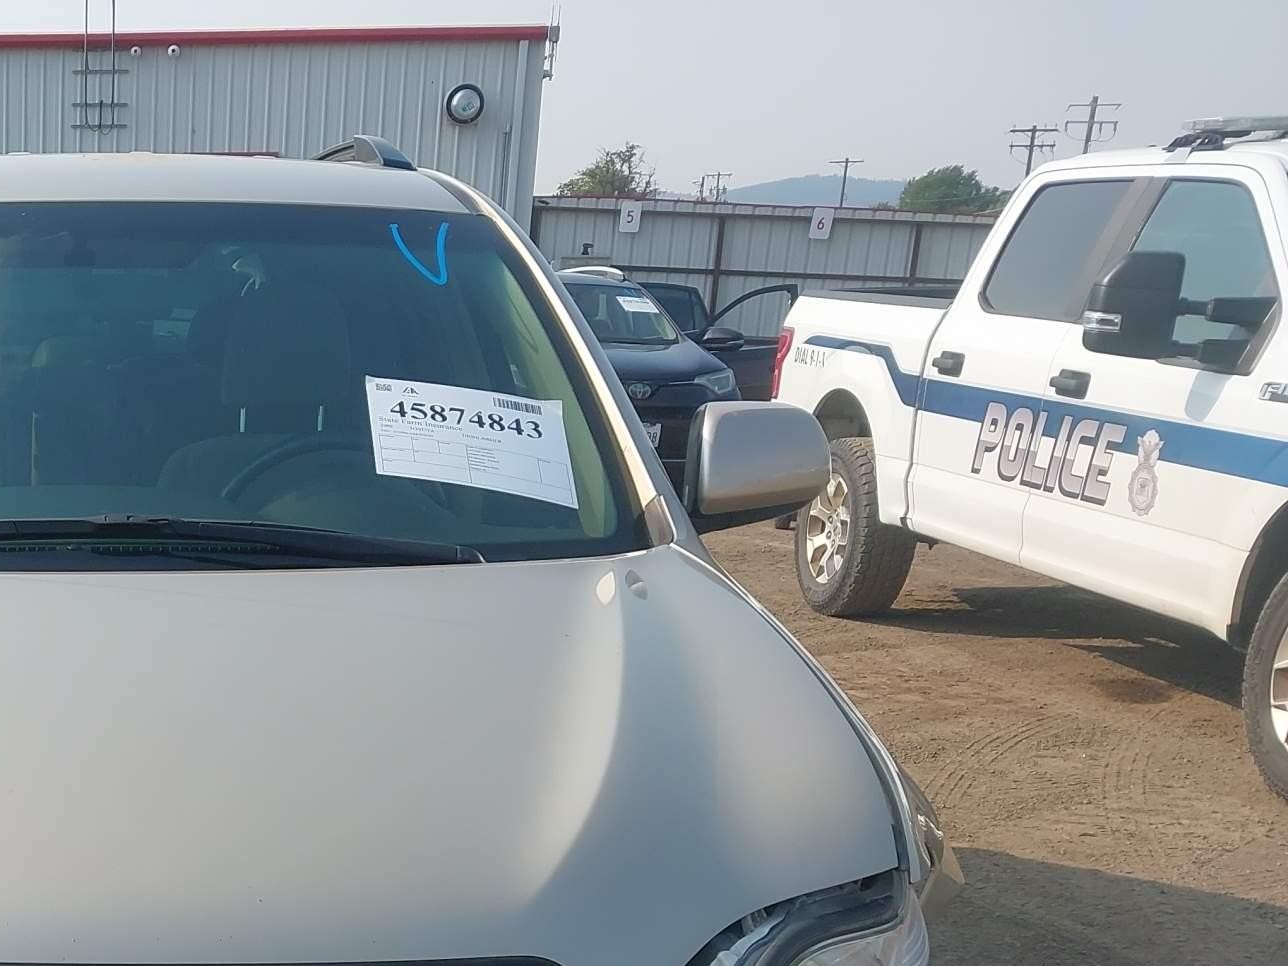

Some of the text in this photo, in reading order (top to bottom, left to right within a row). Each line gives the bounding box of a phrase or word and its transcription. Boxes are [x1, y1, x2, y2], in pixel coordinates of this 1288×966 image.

[626, 209, 635, 224] 5
[817, 216, 825, 231] 6
[794, 346, 826, 368] DIAL 9-1-1
[390, 400, 544, 439] 45874843
[971, 402, 1128, 506] POLICE
